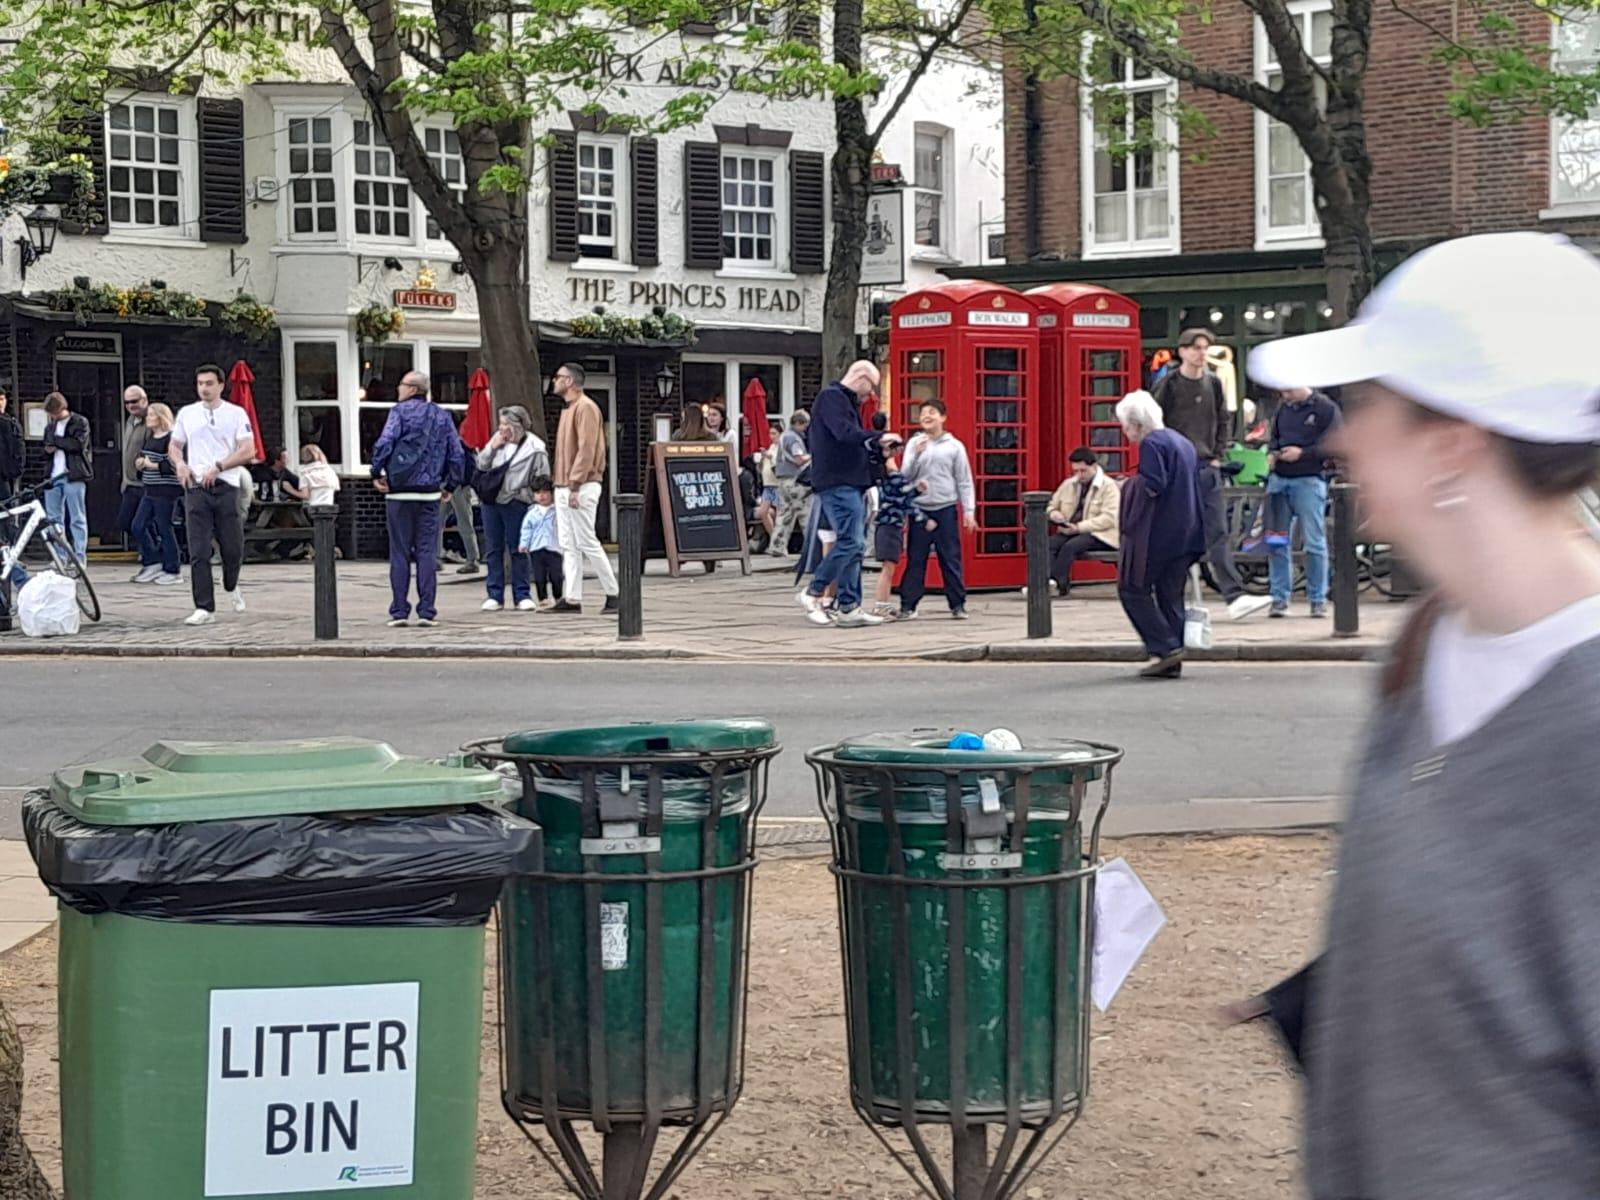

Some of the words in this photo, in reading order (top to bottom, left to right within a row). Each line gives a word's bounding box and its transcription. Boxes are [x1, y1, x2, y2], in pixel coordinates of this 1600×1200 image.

[566, 277, 616, 303] THE
[630, 281, 727, 309] PRINCES
[738, 286, 801, 312] HEAD
[902, 314, 949, 326] TELEPHONE
[1076, 314, 1126, 325] TELEPHONE
[672, 472, 697, 485] YOUR
[697, 471, 726, 483] LOCAL
[679, 484, 699, 498] FOR
[700, 482, 724, 496] LIVE
[685, 495, 724, 510] SPORTS
[221, 1019, 407, 1079] LITTER
[266, 1099, 359, 1155] BIN
